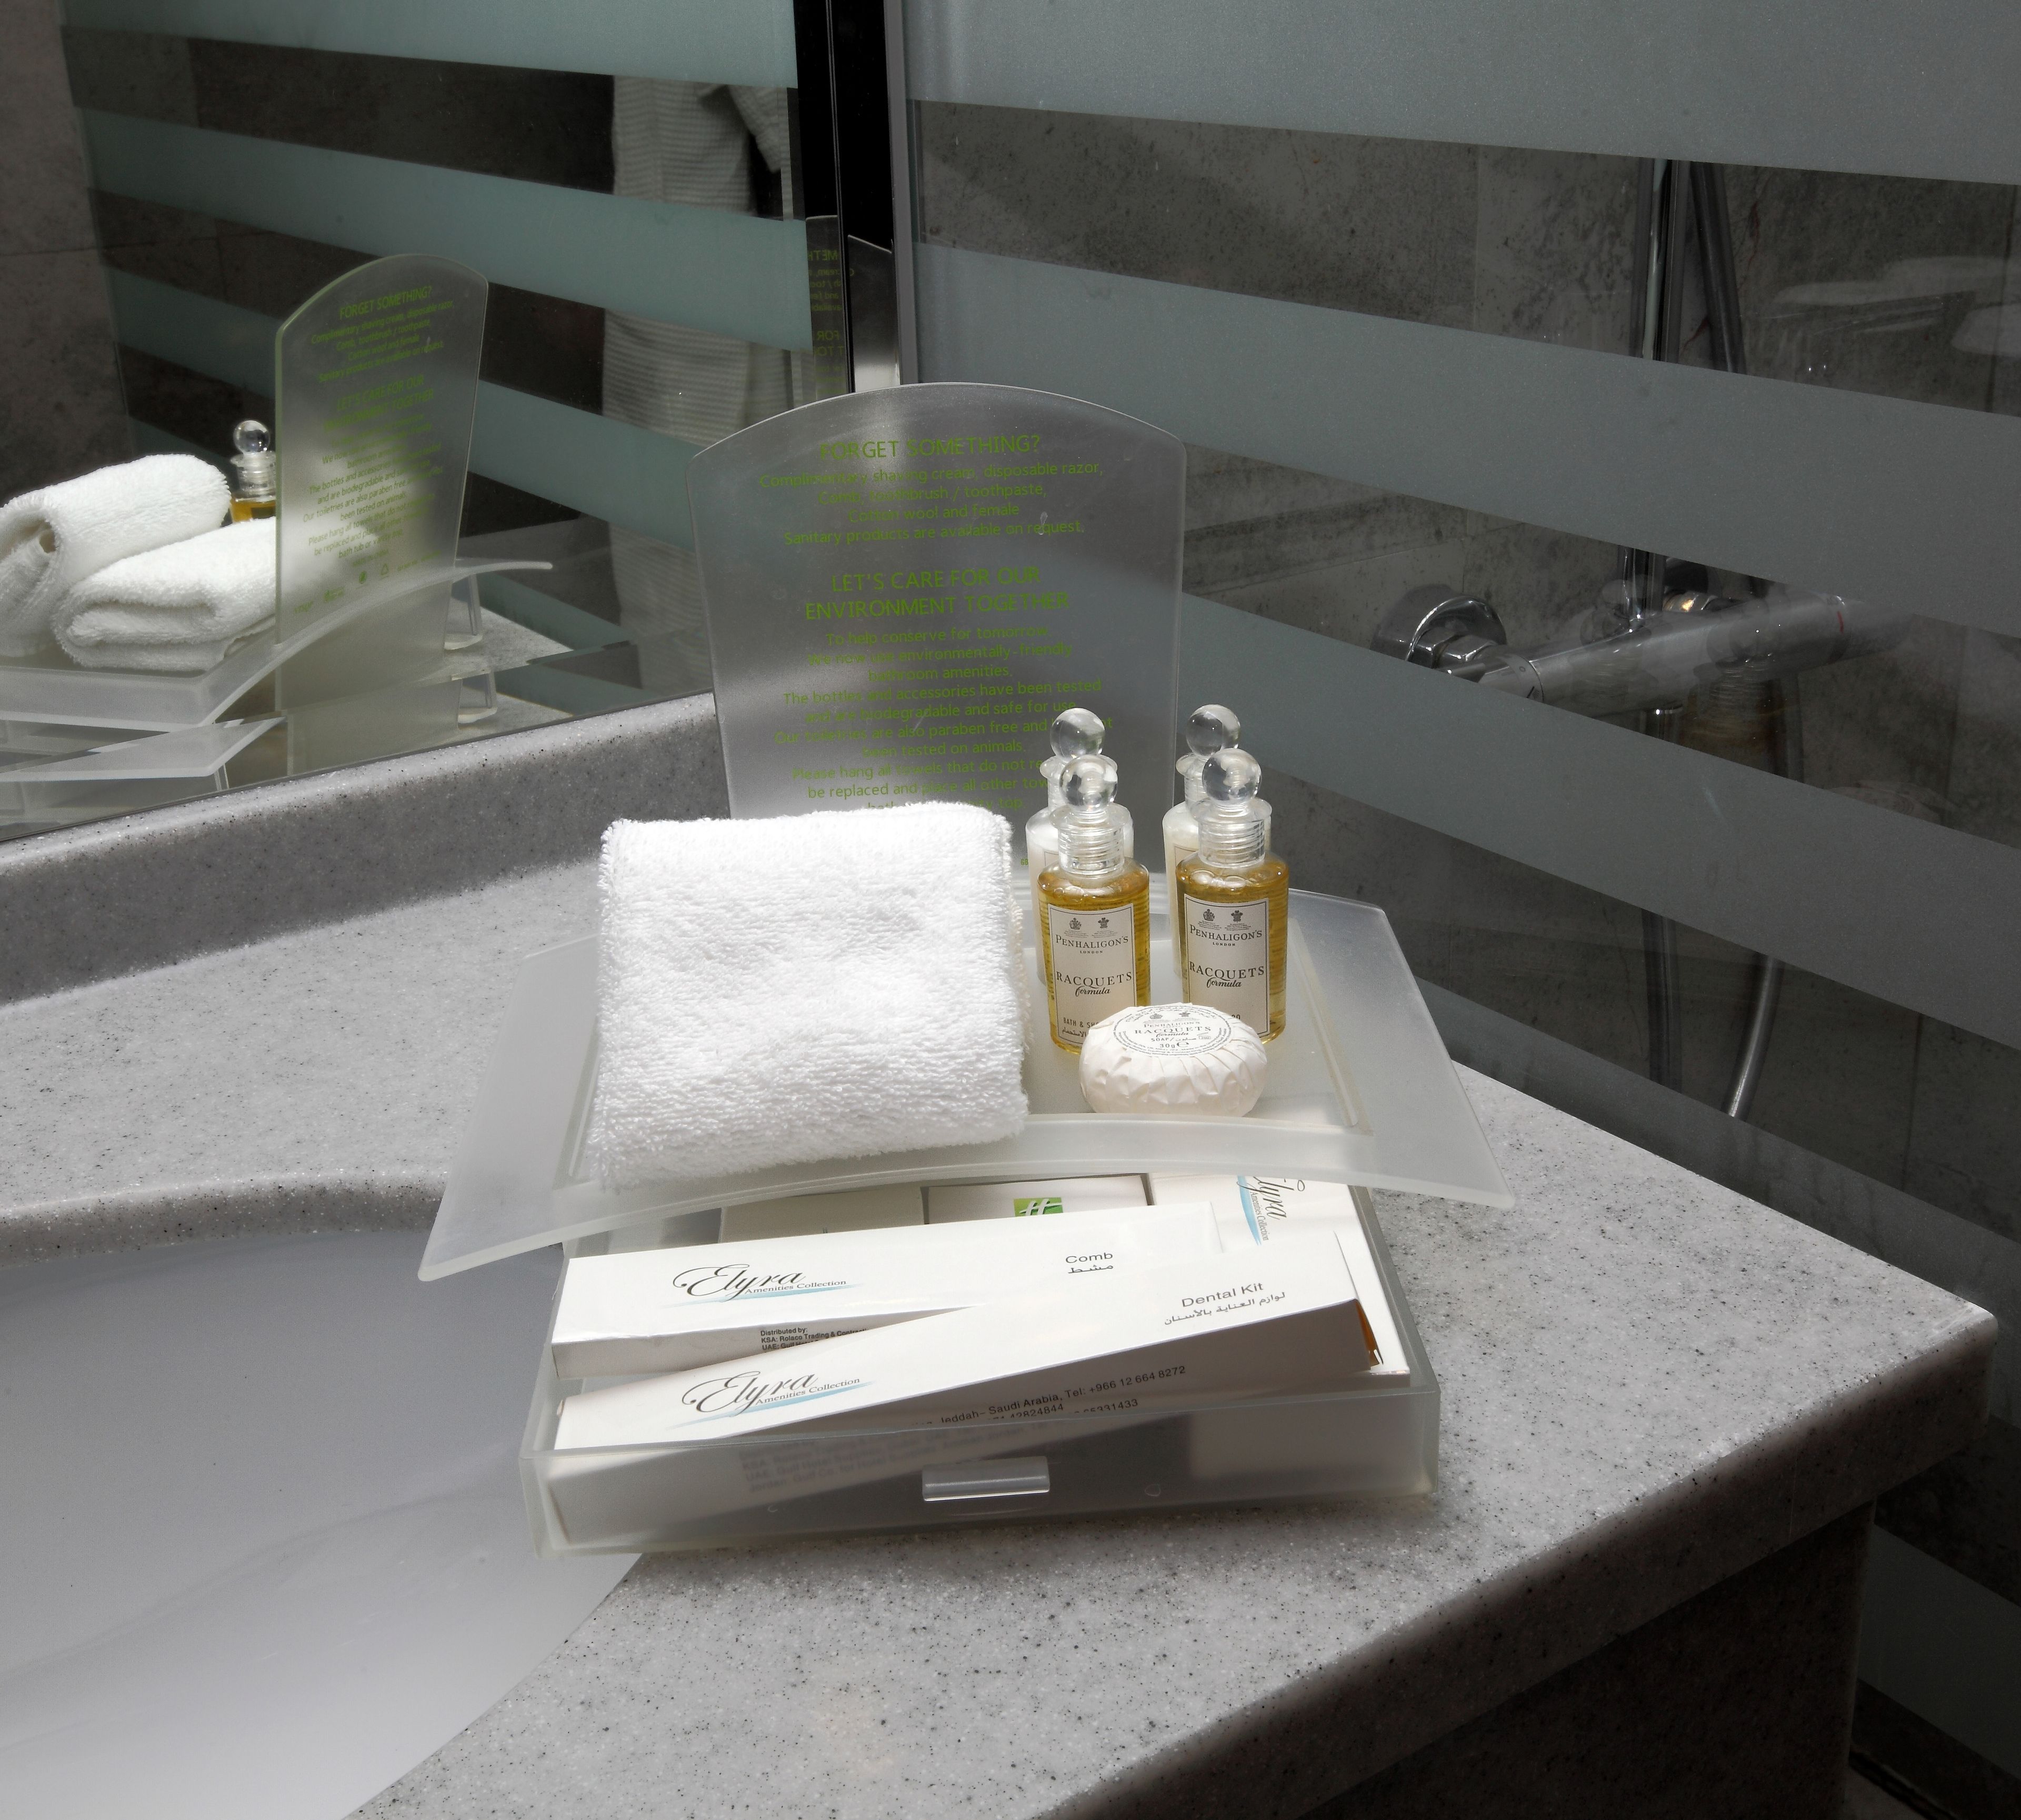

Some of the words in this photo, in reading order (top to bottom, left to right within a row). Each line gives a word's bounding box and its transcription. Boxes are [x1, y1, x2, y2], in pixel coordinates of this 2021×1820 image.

[339, 300, 374, 320] FORGET
[377, 286, 432, 311] SOMETHING?
[820, 441, 899, 460] FORGET
[907, 435, 1040, 457] SOMETHING?
[759, 471, 867, 488] Complimentary
[874, 469, 927, 484] shaving
[984, 462, 1057, 480] disposable
[1062, 463, 1103, 476] razor,
[818, 492, 864, 505] Comb,
[869, 485, 948, 501] toothbrush
[964, 483, 1048, 499] toothpaste,
[303, 512, 315, 522] Our
[848, 508, 899, 523] Cotton
[904, 505, 938, 519] wool
[943, 505, 967, 518] and
[973, 503, 1019, 516] female
[784, 531, 842, 546] Sanitary
[846, 528, 909, 545] products
[914, 528, 935, 539] are
[941, 523, 1000, 538] available
[1006, 524, 1023, 535] on
[1027, 521, 1084, 536] request.
[831, 572, 885, 592] LET'S
[891, 571, 944, 590] CARE
[951, 568, 989, 587] FOR
[997, 566, 1040, 585] OUR
[805, 596, 956, 620] ENVIRONMENT
[964, 592, 1069, 613] TOGETHER
[826, 633, 843, 646] To
[847, 631, 876, 646] help
[882, 631, 946, 644] conserve
[951, 627, 972, 641] for
[807, 654, 831, 666] We
[836, 654, 865, 665] now
[871, 651, 894, 663] use
[868, 668, 938, 682] bathroom
[943, 664, 1012, 678] amenities.
[783, 692, 808, 704] The
[813, 690, 862, 704] bottles
[867, 688, 892, 701] and
[897, 684, 975, 700] accessories
[980, 684, 1013, 696] have
[1018, 682, 1052, 694] been
[1056, 678, 1102, 692] tested
[805, 712, 830, 723] and
[835, 711, 856, 722] are
[860, 704, 959, 722] biodegradable
[965, 703, 989, 715] and
[994, 702, 1022, 714] safe
[1027, 699, 1047, 712] for
[774, 730, 799, 744] Our
[805, 728, 867, 742] toiletries
[872, 728, 893, 739] are
[898, 724, 925, 737] also
[929, 722, 985, 738] paraben
[989, 721, 1017, 733] free
[1023, 719, 1047, 732] and
[862, 745, 897, 758] been
[902, 743, 946, 756] tested
[951, 743, 968, 754] on
[973, 739, 1026, 753] animals.
[792, 768, 836, 780] Please
[840, 766, 873, 780] hang
[878, 764, 892, 777] all
[896, 762, 942, 776] towels
[947, 761, 974, 773] that
[979, 759, 997, 772] do
[1002, 759, 1025, 771] not
[808, 787, 825, 798] be
[829, 783, 888, 799] replaced
[894, 782, 917, 795] and
[922, 780, 957, 796] place
[963, 778, 975, 791] all
[981, 777, 1016, 790] other
[1056, 935, 1128, 948] PENHALIGON'S
[1189, 924, 1262, 941] PENHALIGON'S
[1056, 971, 1132, 988] RACQUETS
[1189, 961, 1264, 981] RACQUETS
[1075, 986, 1110, 997] formula
[1206, 977, 1242, 988] formula
[1063, 1017, 1076, 1026] BATH
[1135, 1026, 1211, 1035] RACQUETS
[1250, 1191, 1263, 1215] Amenities
[1257, 1215, 1269, 1241] Collection
[1066, 1252, 1113, 1264] Comb
[1068, 1264, 1114, 1274] مشط
[673, 1264, 806, 1302] Elyra
[745, 1284, 794, 1294] Amenities
[797, 1279, 846, 1289] Collection
[1182, 1288, 1236, 1307] Dental
[1241, 1282, 1264, 1294] Kit
[1259, 1292, 1285, 1306] لوازم
[1216, 1298, 1255, 1313] العناية
[761, 1328, 796, 1336] Distributed
[682, 1371, 818, 1417] Elyra
[756, 1392, 806, 1405] Amenities
[809, 1378, 860, 1394] Collection
[989, 1401, 1020, 1415] Saudi
[1024, 1394, 1063, 1408] Arabia,
[1065, 1388, 1086, 1398] Tel:
[1089, 1381, 1117, 1393] +966
[1120, 1377, 1133, 1387] 12
[1135, 1373, 1155, 1384] 664
[1158, 1366, 1186, 1379] 8272
